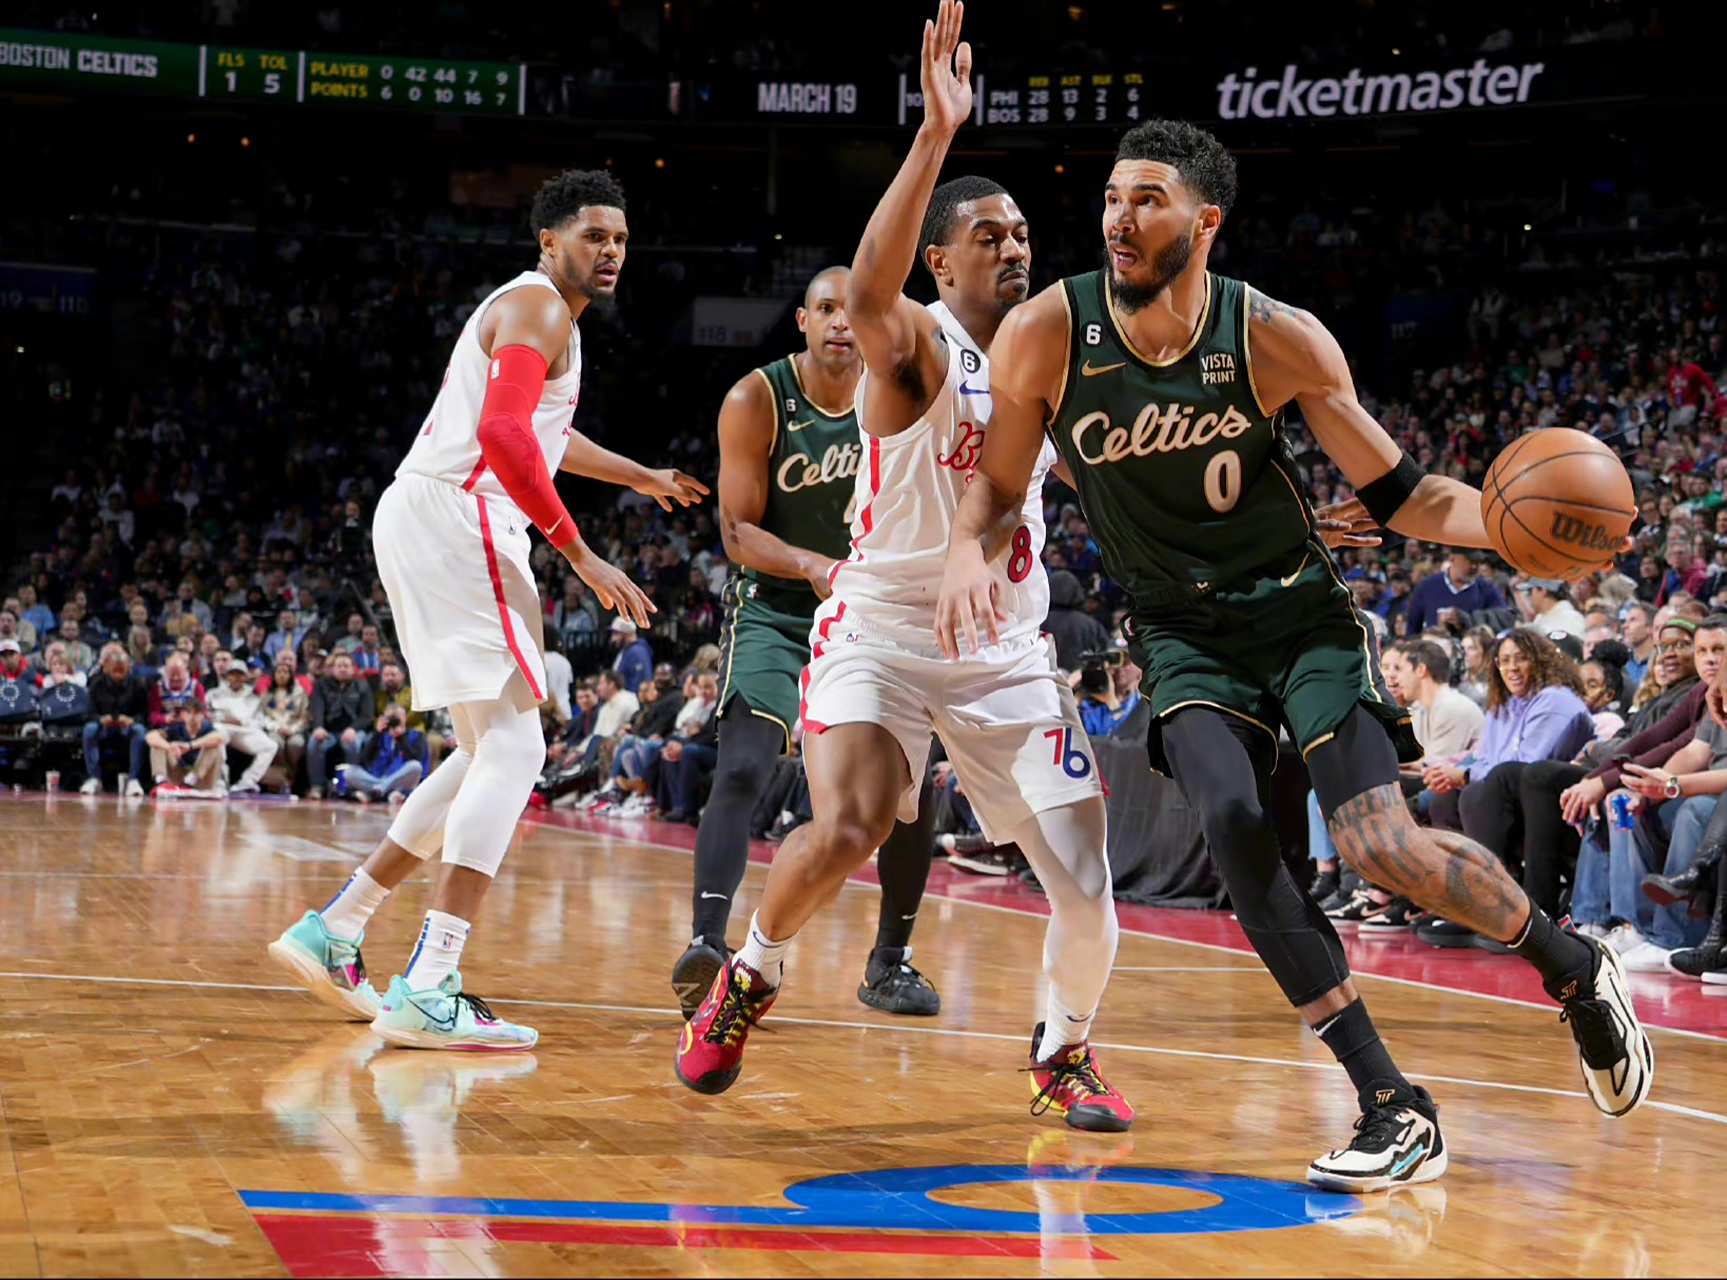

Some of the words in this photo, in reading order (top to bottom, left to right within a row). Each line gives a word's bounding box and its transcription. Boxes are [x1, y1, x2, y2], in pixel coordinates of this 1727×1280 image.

[0, 41, 71, 70] BOSTON
[77, 49, 158, 78] CELTICS
[217, 52, 245, 67] FLS
[258, 54, 288, 70] TOL
[225, 71, 237, 92] 1
[264, 73, 281, 94] 5
[310, 60, 369, 78] PLAYER
[380, 64, 394, 80] 0
[404, 66, 427, 82] 42
[433, 68, 457, 84] 44
[467, 69, 479, 84] 7
[495, 71, 508, 86] 9
[310, 81, 368, 98] POINTS
[380, 85, 393, 100] 6
[408, 86, 422, 102] 0
[434, 88, 454, 103] 10
[463, 90, 483, 105] 16
[495, 92, 507, 106] 7
[758, 82, 831, 113] MARCH
[834, 84, 857, 114] 19
[990, 90, 1019, 106] PHI
[1028, 89, 1050, 105] 28
[1062, 88, 1079, 104] 13
[1096, 88, 1108, 104] 2
[1127, 87, 1140, 102] 6
[1216, 58, 1545, 120] ticketmaster
[987, 107, 1021, 124] BOS
[1027, 107, 1049, 123] 28
[1064, 106, 1076, 121] 9
[1095, 105, 1107, 121] 3
[1127, 105, 1139, 120] 4
[1086, 323, 1102, 345] 6
[962, 350, 977, 372] 6
[1200, 353, 1236, 372] VISTA
[1202, 369, 1236, 385] PRINT
[785, 398, 797, 413] 6
[1071, 402, 1252, 465] Celtics
[776, 441, 862, 493] Celti
[1203, 449, 1242, 514] 0
[1007, 525, 1033, 584] 8
[1043, 726, 1091, 779] 76
